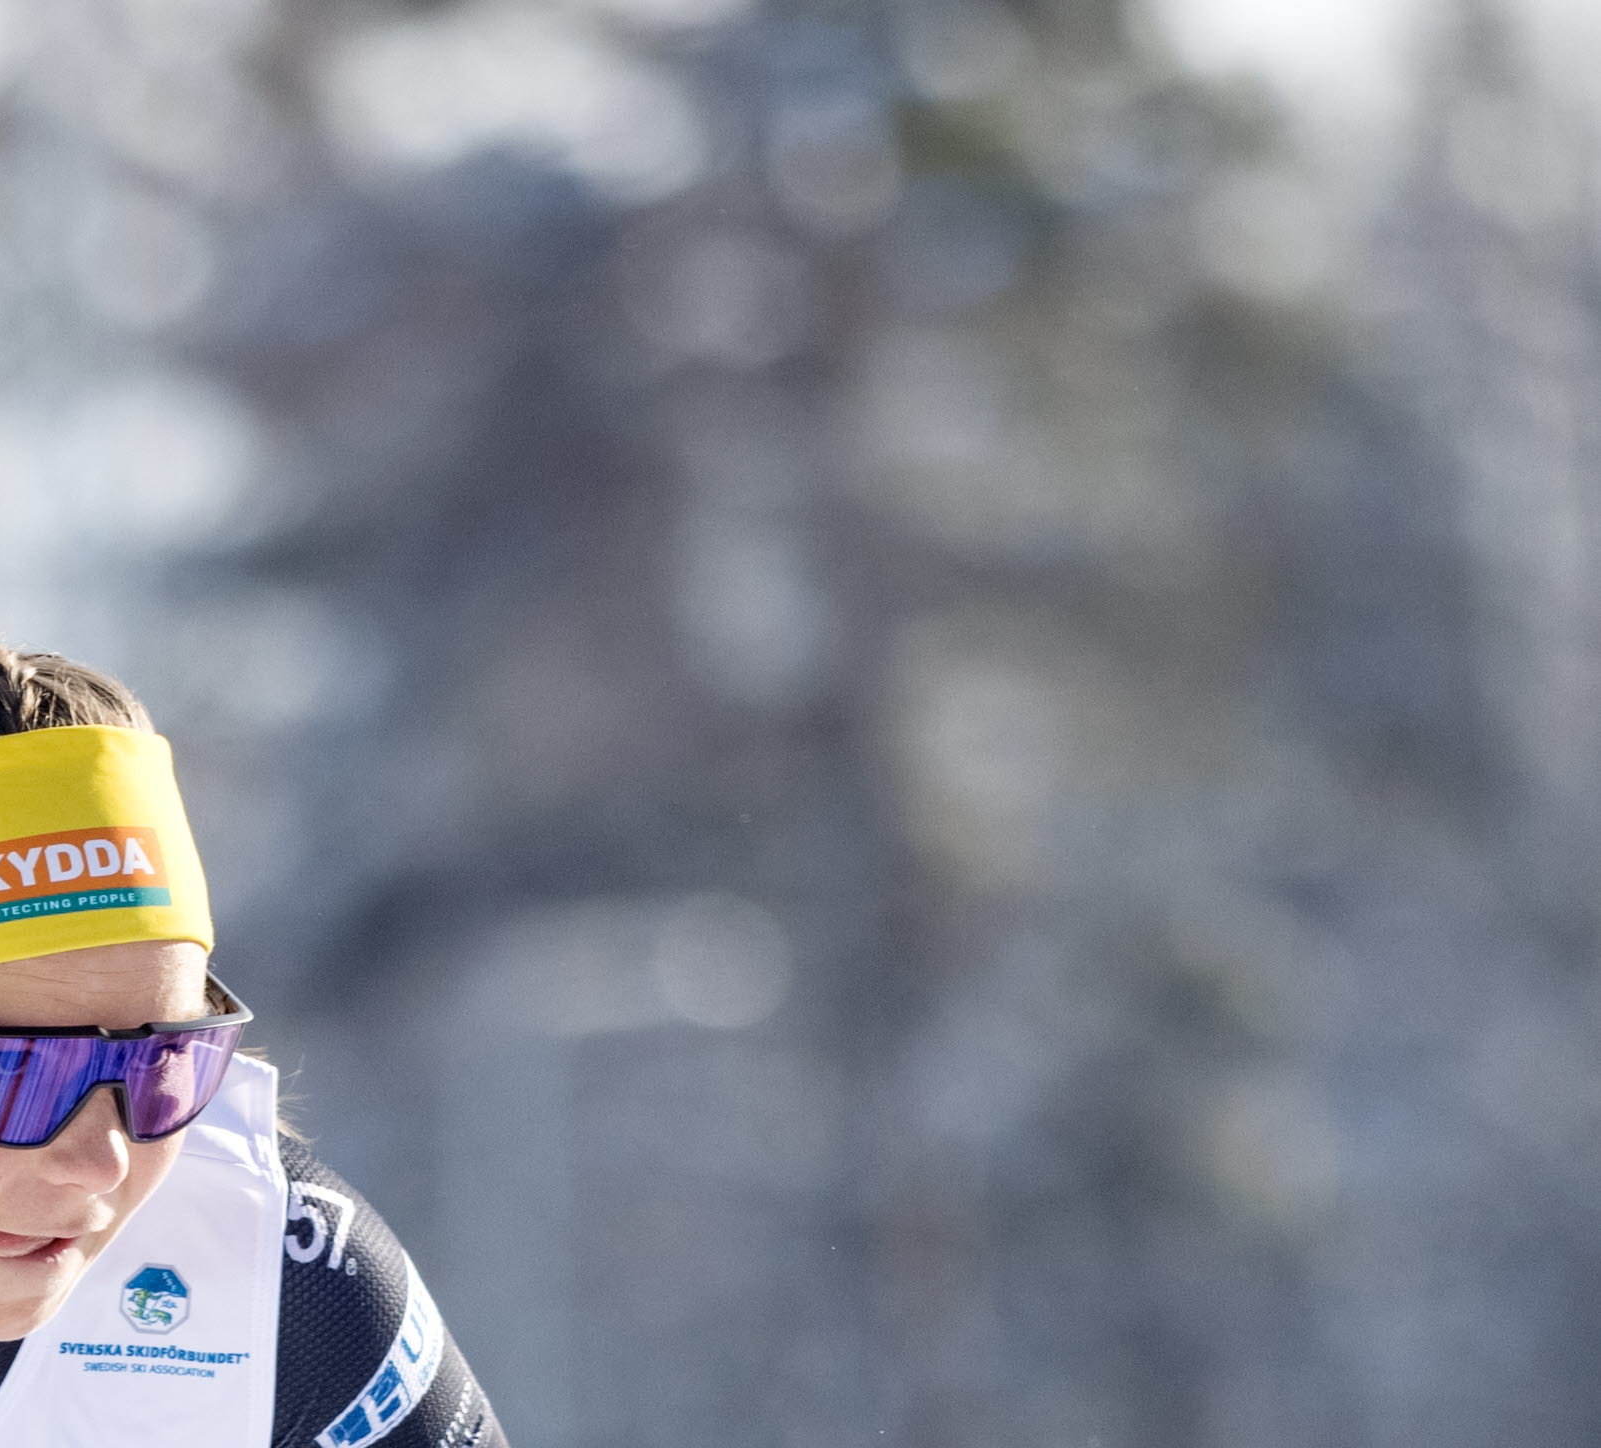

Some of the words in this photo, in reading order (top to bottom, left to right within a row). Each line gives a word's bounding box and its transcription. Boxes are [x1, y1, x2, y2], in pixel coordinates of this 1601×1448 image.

[78, 891, 136, 907] PEOPLE
[59, 1341, 122, 1357] SVENSKA
[126, 1344, 243, 1365] SKIDFÖRBUNDET
[83, 1361, 127, 1373] SWEDISH
[131, 1363, 147, 1374] SKI
[150, 1364, 215, 1379] ASSOCIATION
